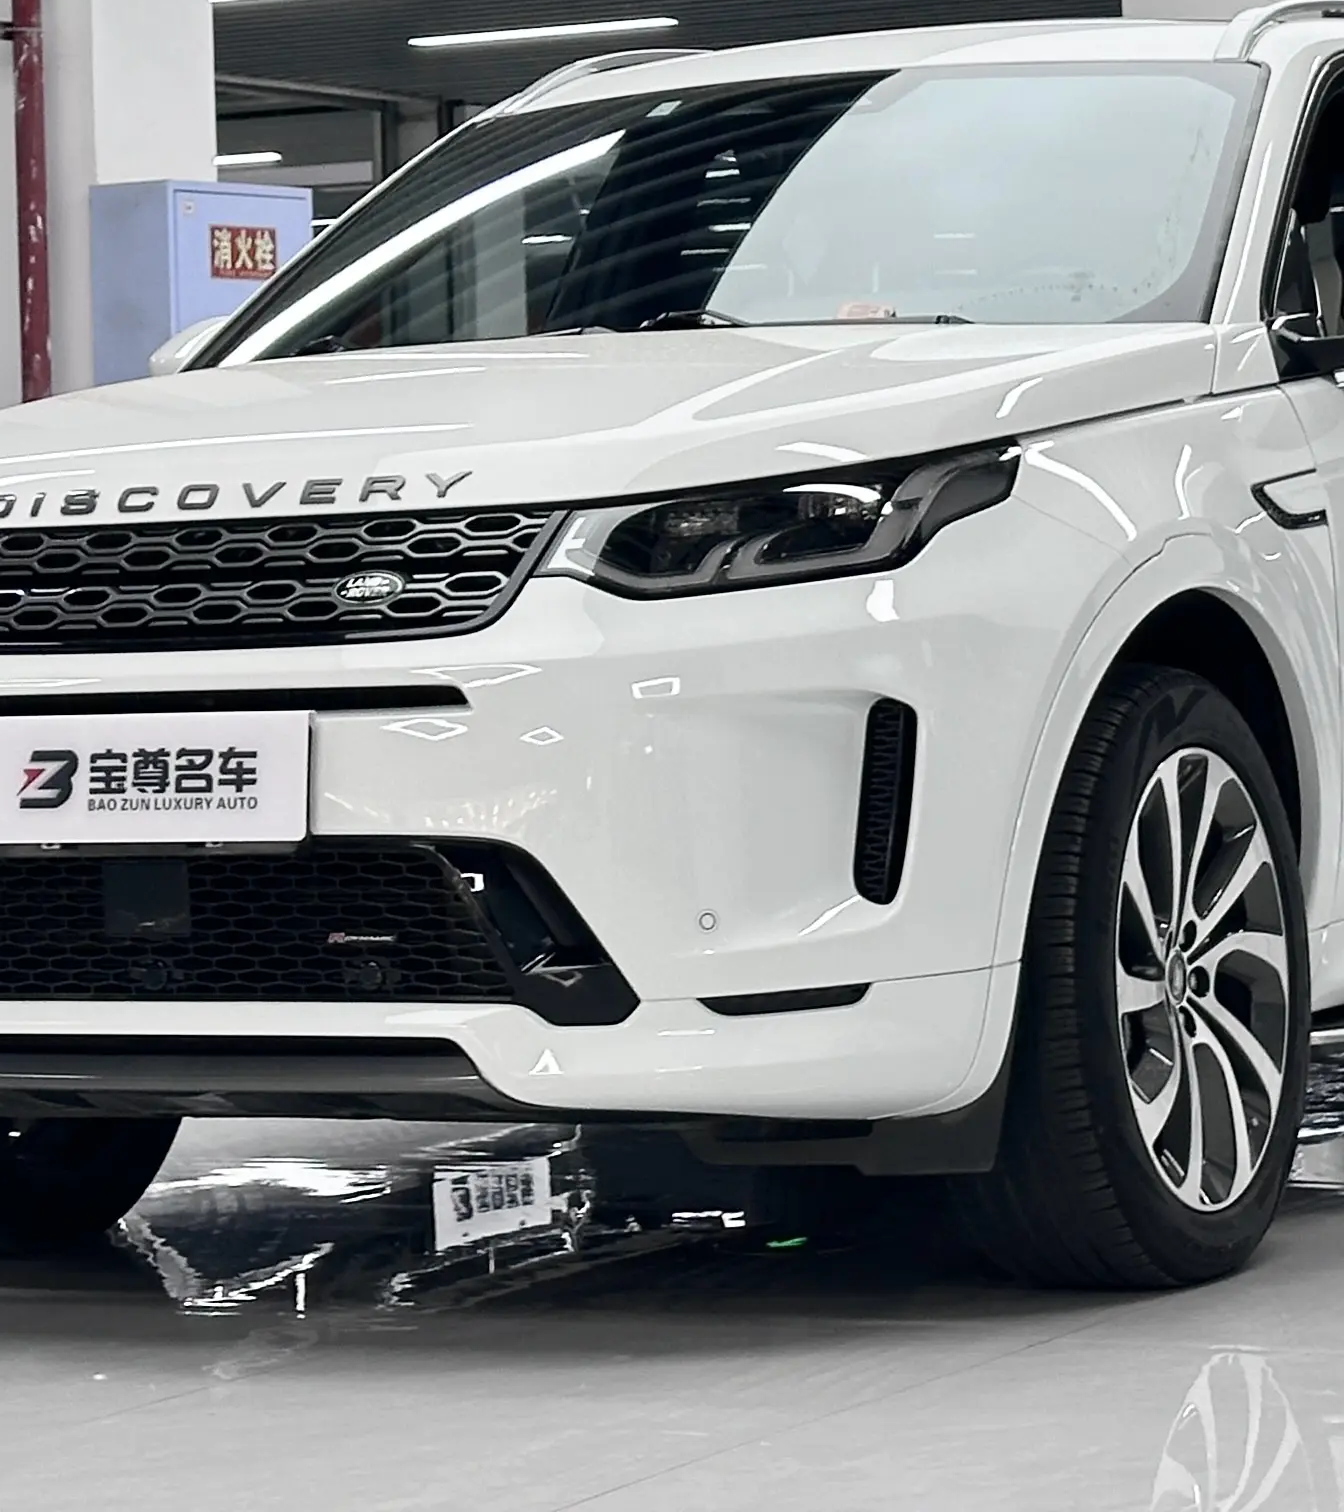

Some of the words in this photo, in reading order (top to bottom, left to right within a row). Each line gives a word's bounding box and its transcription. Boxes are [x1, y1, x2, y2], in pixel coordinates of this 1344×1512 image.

[213, 228, 275, 270] 消火栓
[88, 747, 258, 794] 宝尊名车
[87, 799, 117, 812] BAO
[121, 798, 151, 811] ZUN
[154, 797, 212, 811] LUXURY
[216, 796, 258, 810] AUTO
